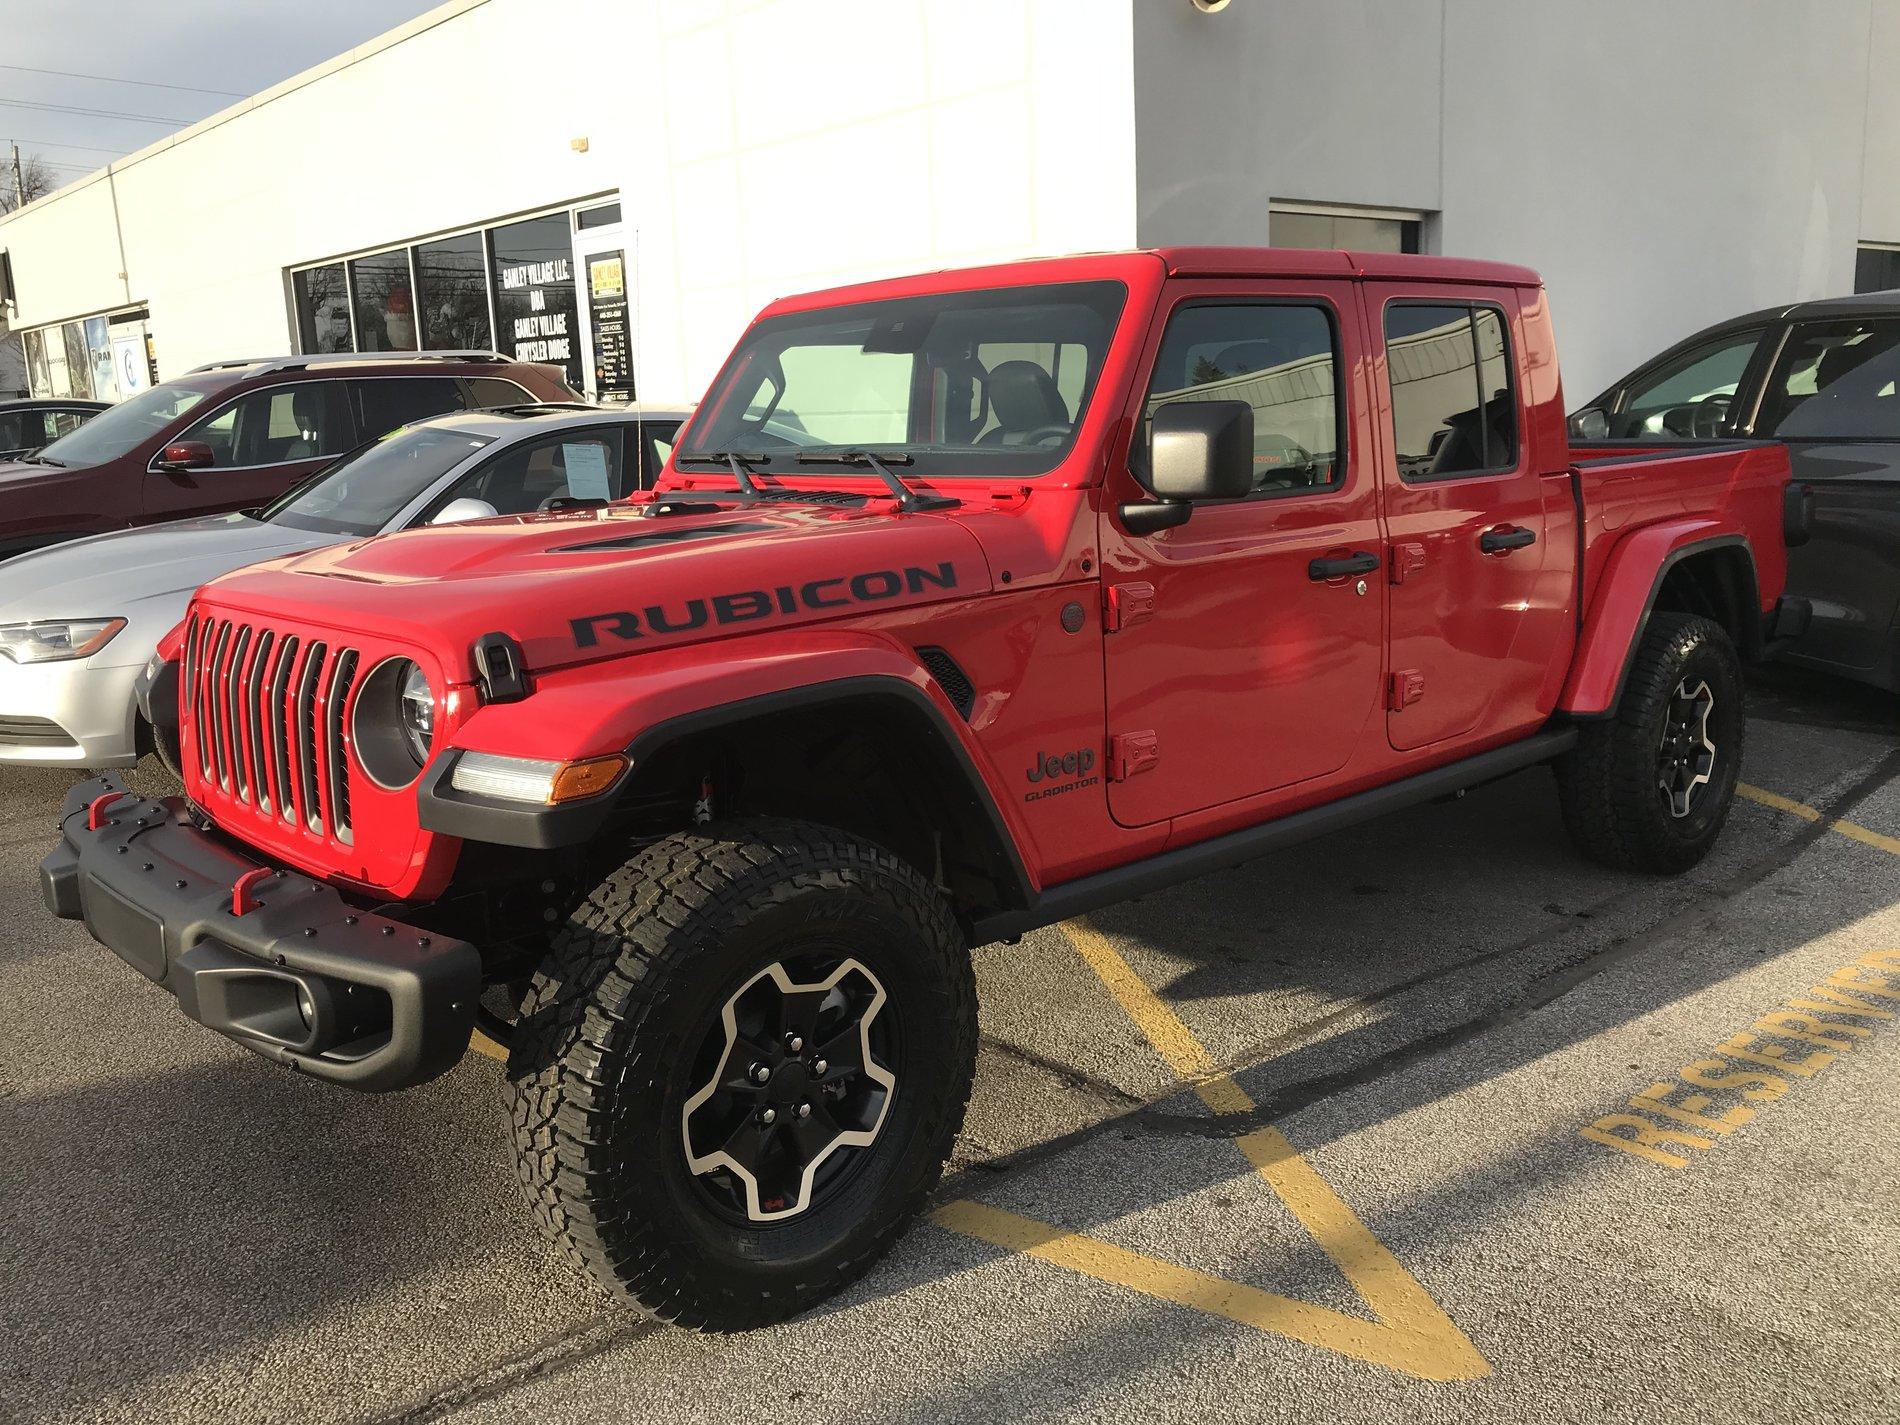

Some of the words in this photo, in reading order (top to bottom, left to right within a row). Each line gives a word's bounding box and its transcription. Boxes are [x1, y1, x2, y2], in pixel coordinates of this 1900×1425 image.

[503, 266, 527, 289] GANLEY
[527, 261, 555, 286] VILLAGE
[514, 317, 539, 339] GANLEY
[539, 313, 567, 337] VILLAGE
[515, 340, 548, 363] CHRYSLER
[548, 338, 571, 360] DODGE
[569, 562, 957, 648] RUBICON
[1026, 747, 1095, 783] Jeep
[1024, 776, 1099, 802] GLADIATOR
